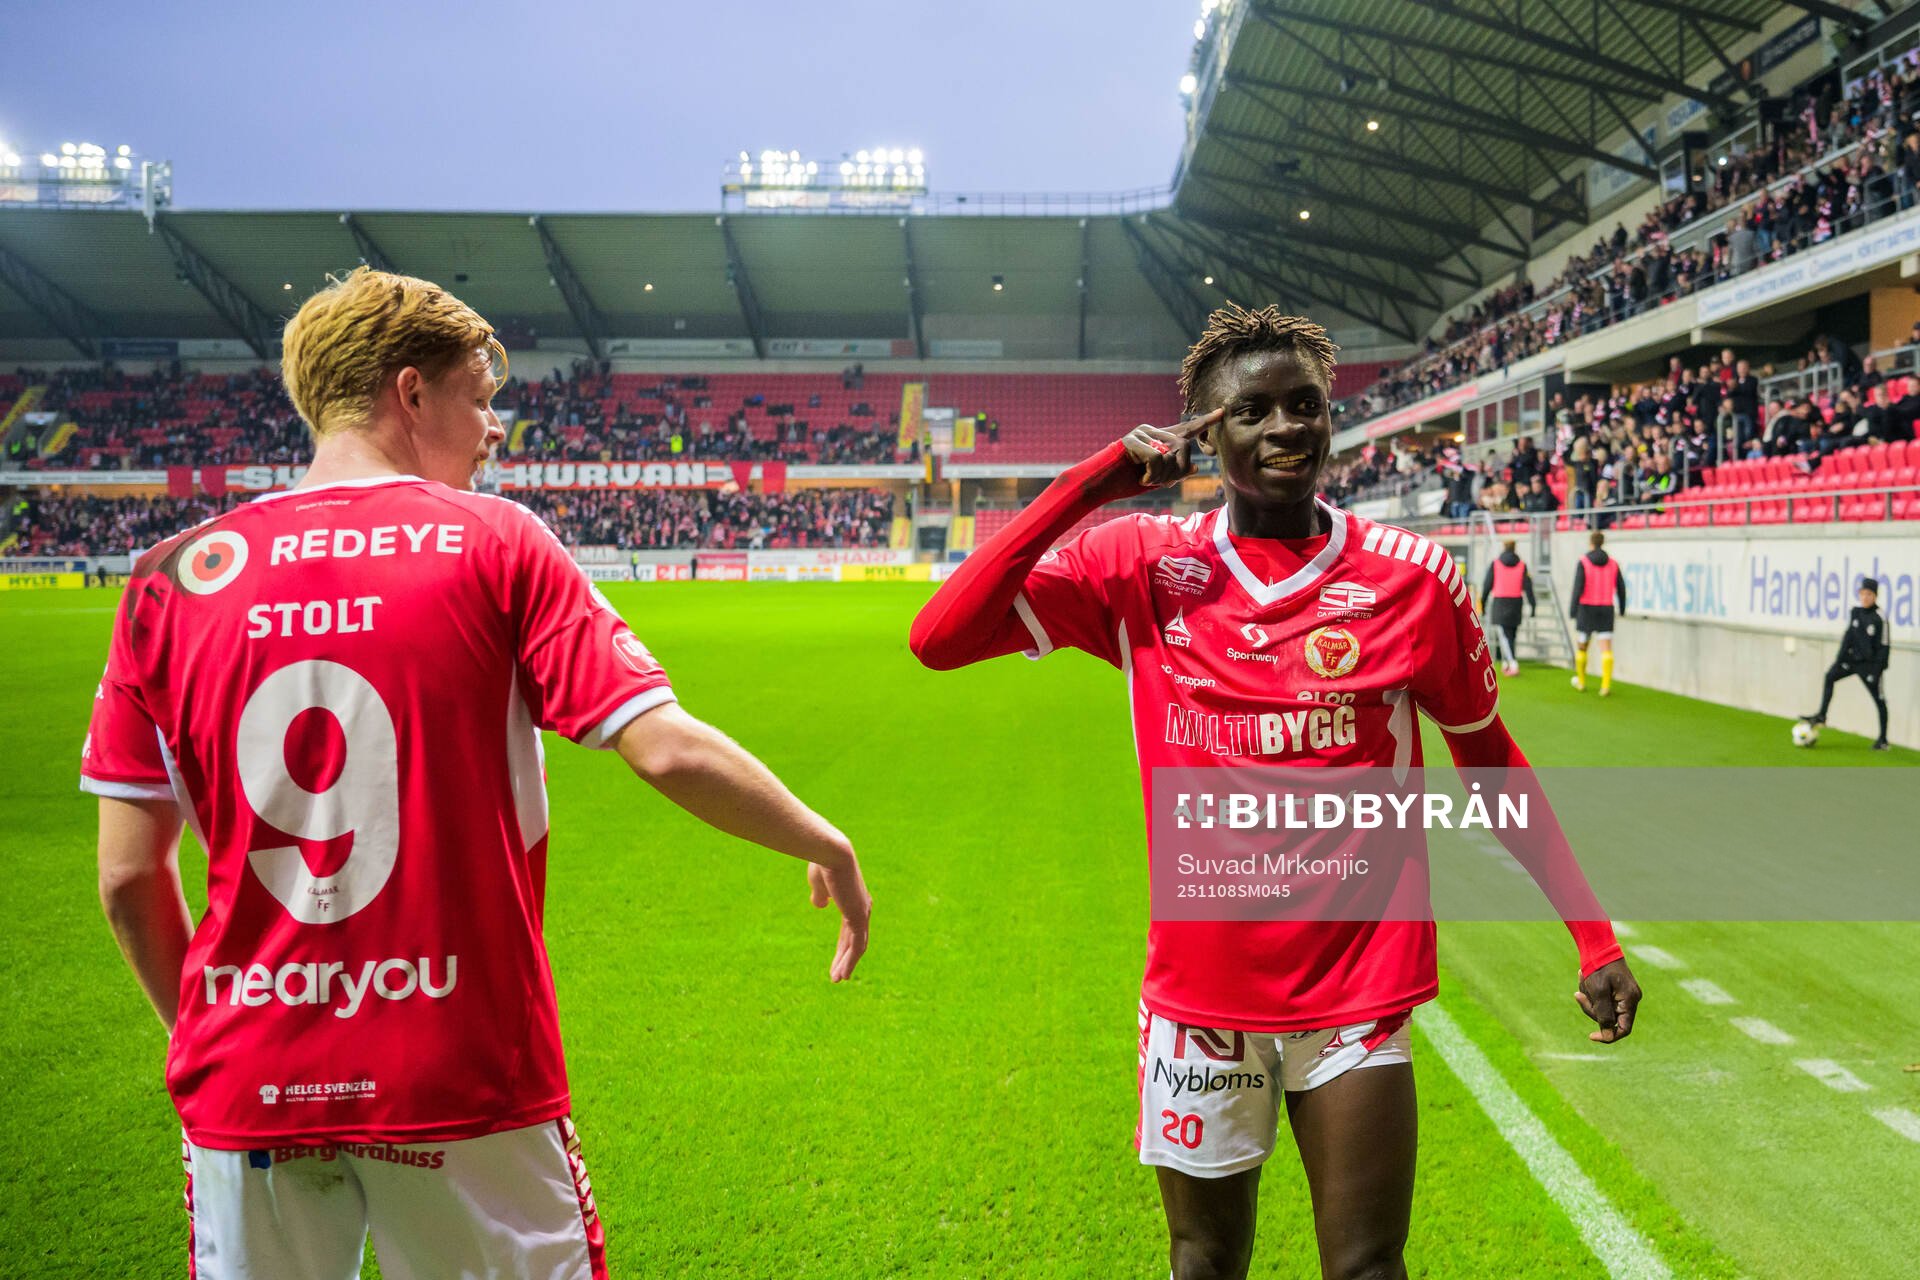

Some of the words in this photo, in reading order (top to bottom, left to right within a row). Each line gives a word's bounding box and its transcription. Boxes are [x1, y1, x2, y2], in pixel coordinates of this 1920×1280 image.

[514, 463, 706, 488] KURVAN
[270, 523, 465, 567] REDEYE
[817, 551, 897, 565] SHARP
[9, 576, 58, 586] HYLTE
[864, 566, 906, 577] HYLTE
[1751, 555, 1920, 628] Handelba
[247, 596, 383, 640] STOLT
[1317, 638, 1349, 650] KALMAR
[1226, 647, 1279, 665] Sportway
[1325, 652, 1338, 667] FF
[1174, 673, 1217, 690] gruppen
[236, 658, 400, 925] 9
[203, 955, 458, 1019] nearyou
[1153, 1056, 1265, 1098] Nybloms
[285, 1084, 323, 1097] HELGE
[323, 1079, 377, 1095] SVENZÉN
[1160, 1108, 1204, 1150] 20
